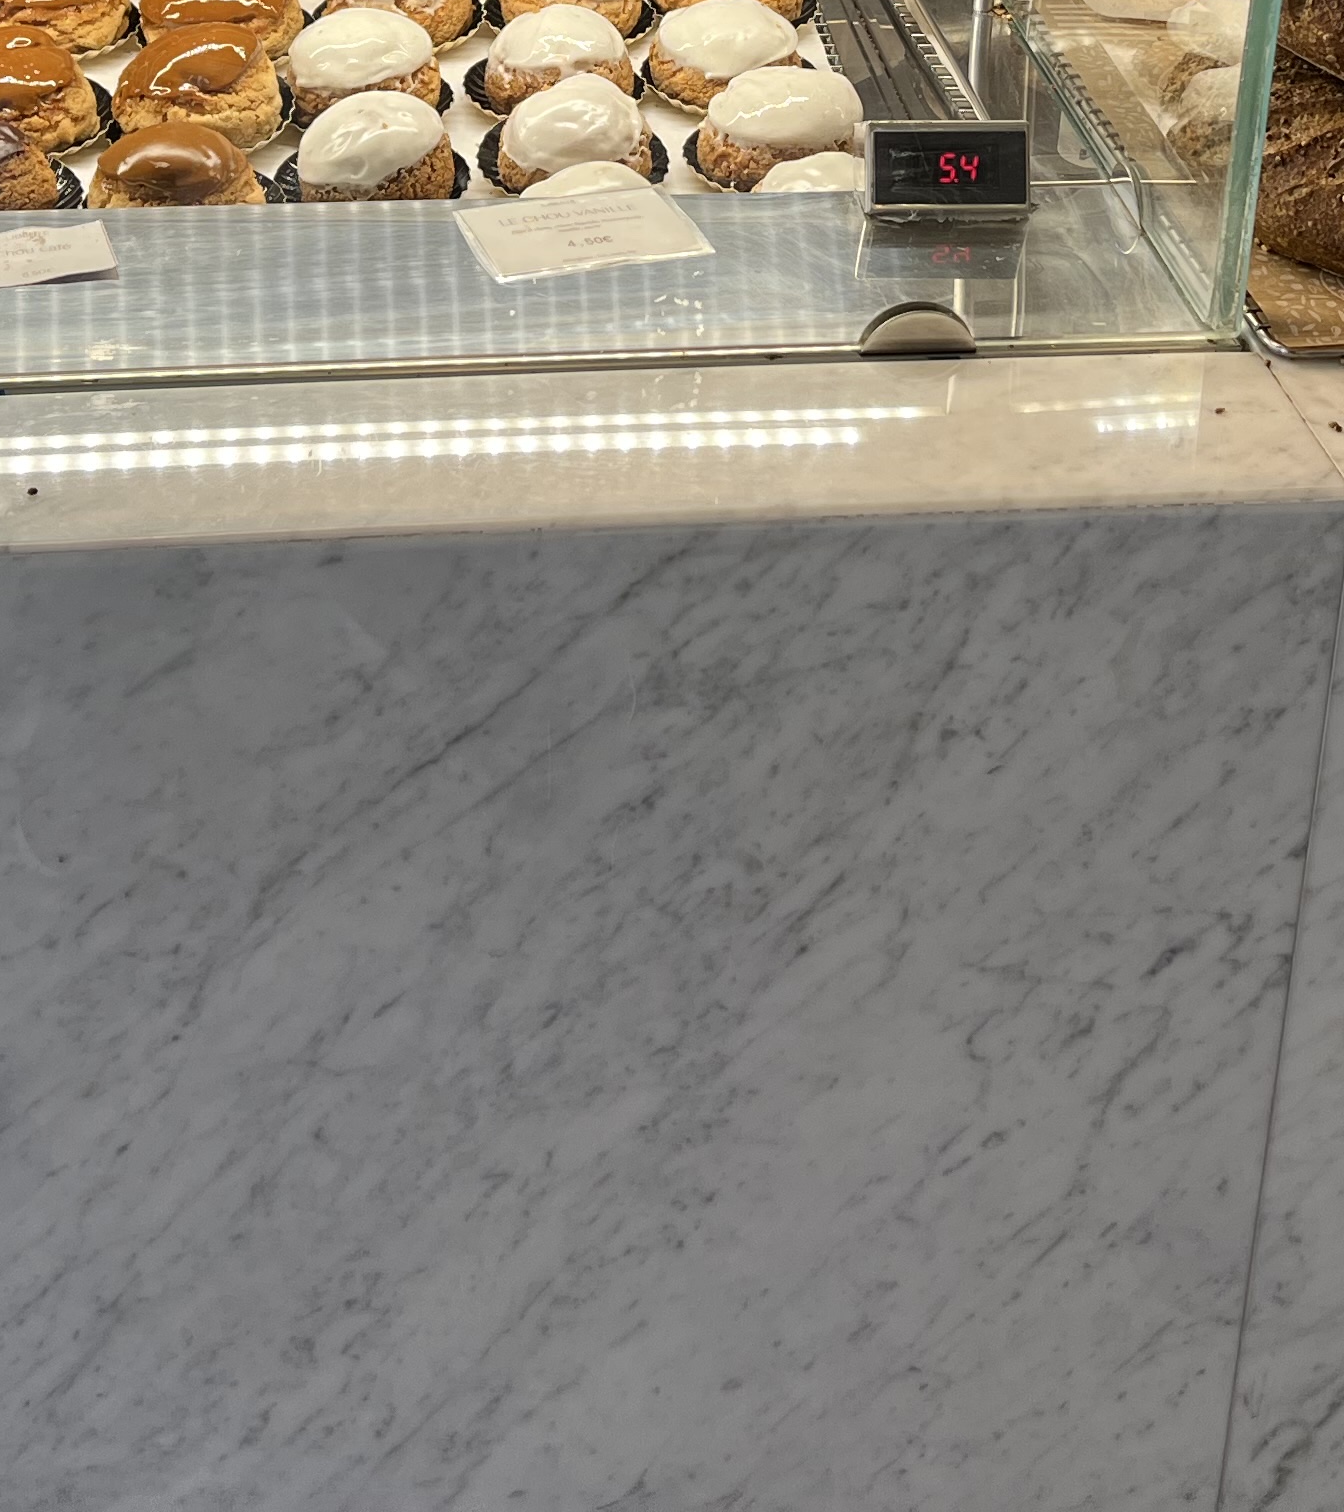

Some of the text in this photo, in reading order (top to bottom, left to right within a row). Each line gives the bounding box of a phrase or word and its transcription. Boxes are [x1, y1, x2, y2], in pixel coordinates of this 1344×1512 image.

[938, 152, 981, 184] 5.4
[498, 217, 518, 227] LE
[522, 212, 571, 224] CHOU
[572, 204, 637, 217] VANILLE
